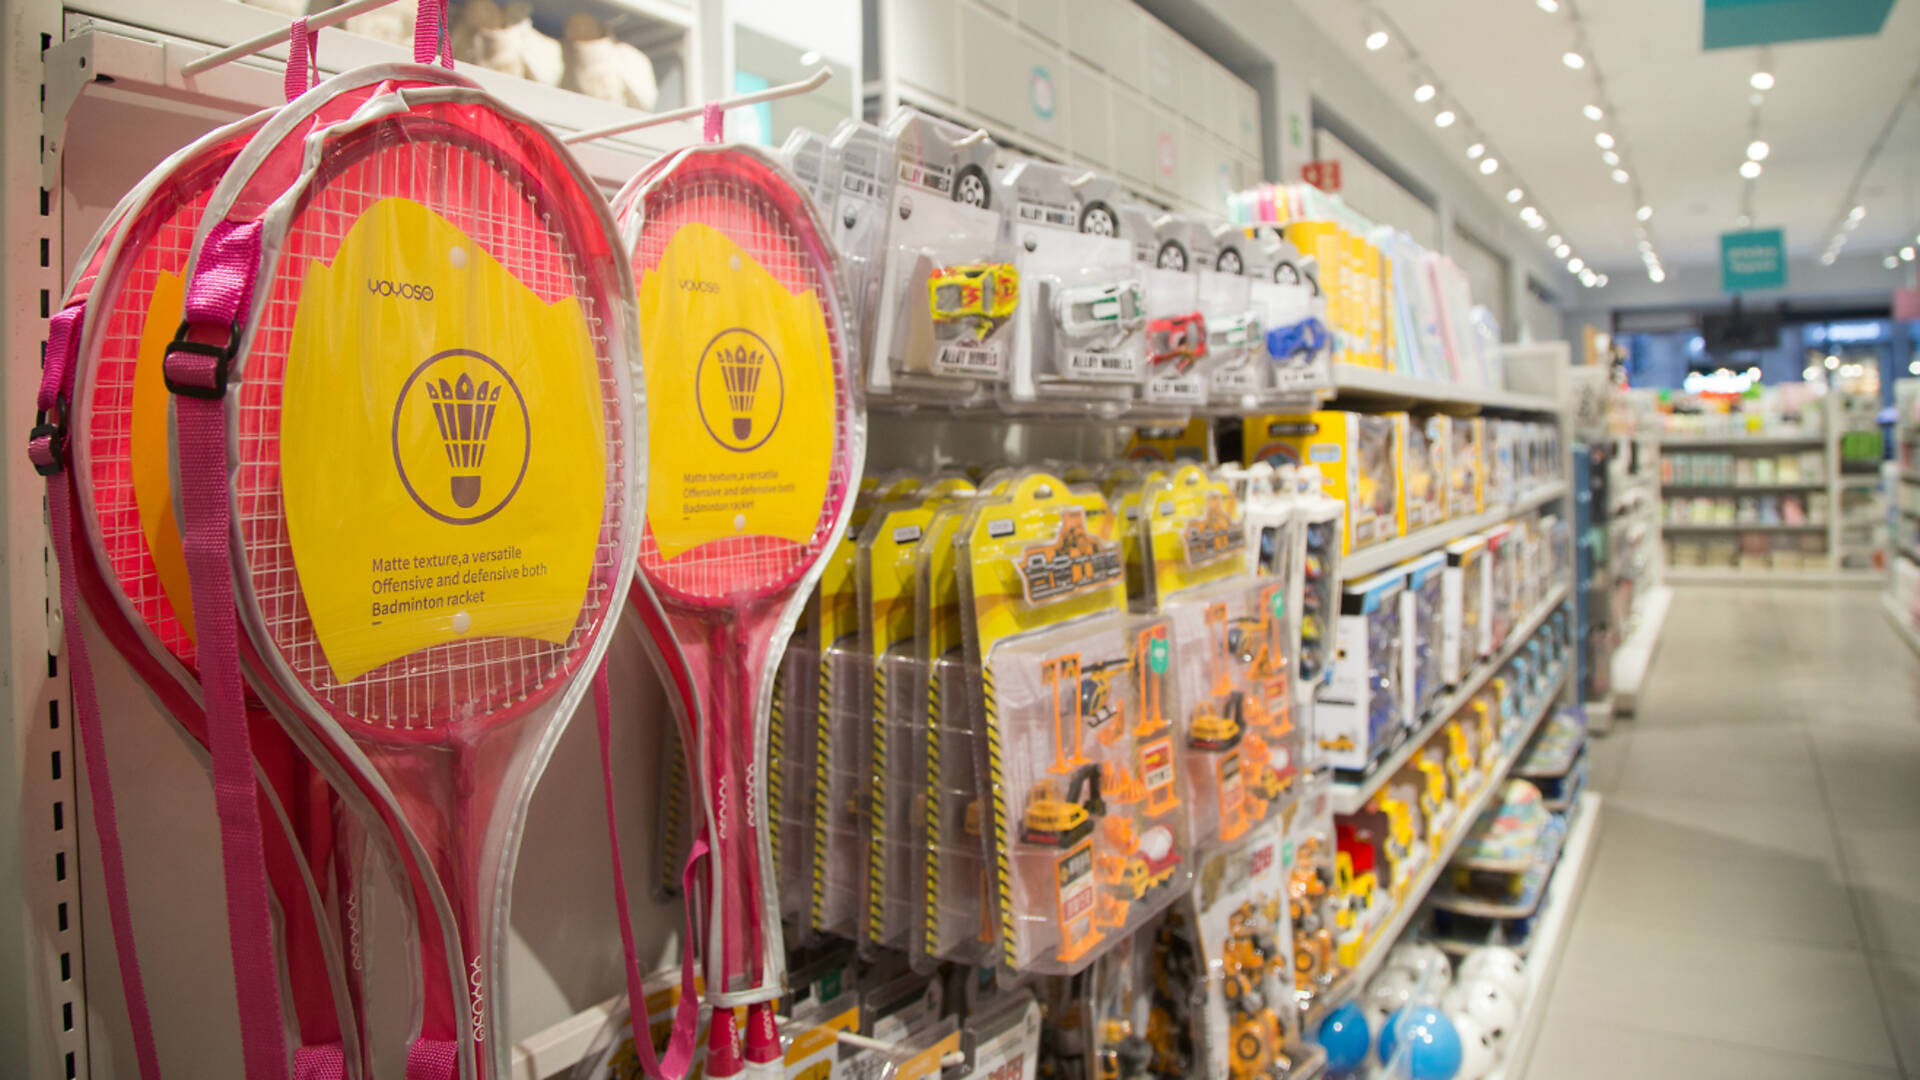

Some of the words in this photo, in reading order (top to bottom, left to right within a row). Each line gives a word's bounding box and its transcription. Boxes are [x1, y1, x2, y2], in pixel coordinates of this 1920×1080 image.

[368, 278, 434, 301] YOYOSO
[1071, 354, 1098, 369] ALLOY
[683, 487, 722, 499] Offensive
[723, 486, 738, 496] and
[683, 502, 729, 514] Badminton
[730, 500, 754, 510] racket
[372, 557, 411, 573] Matte
[472, 545, 522, 563] versatile
[372, 577, 434, 595] Offensive
[436, 570, 460, 588] and
[462, 565, 519, 585] defensive
[521, 561, 548, 578] both
[372, 597, 444, 617] Badminton
[447, 590, 485, 607] racket
